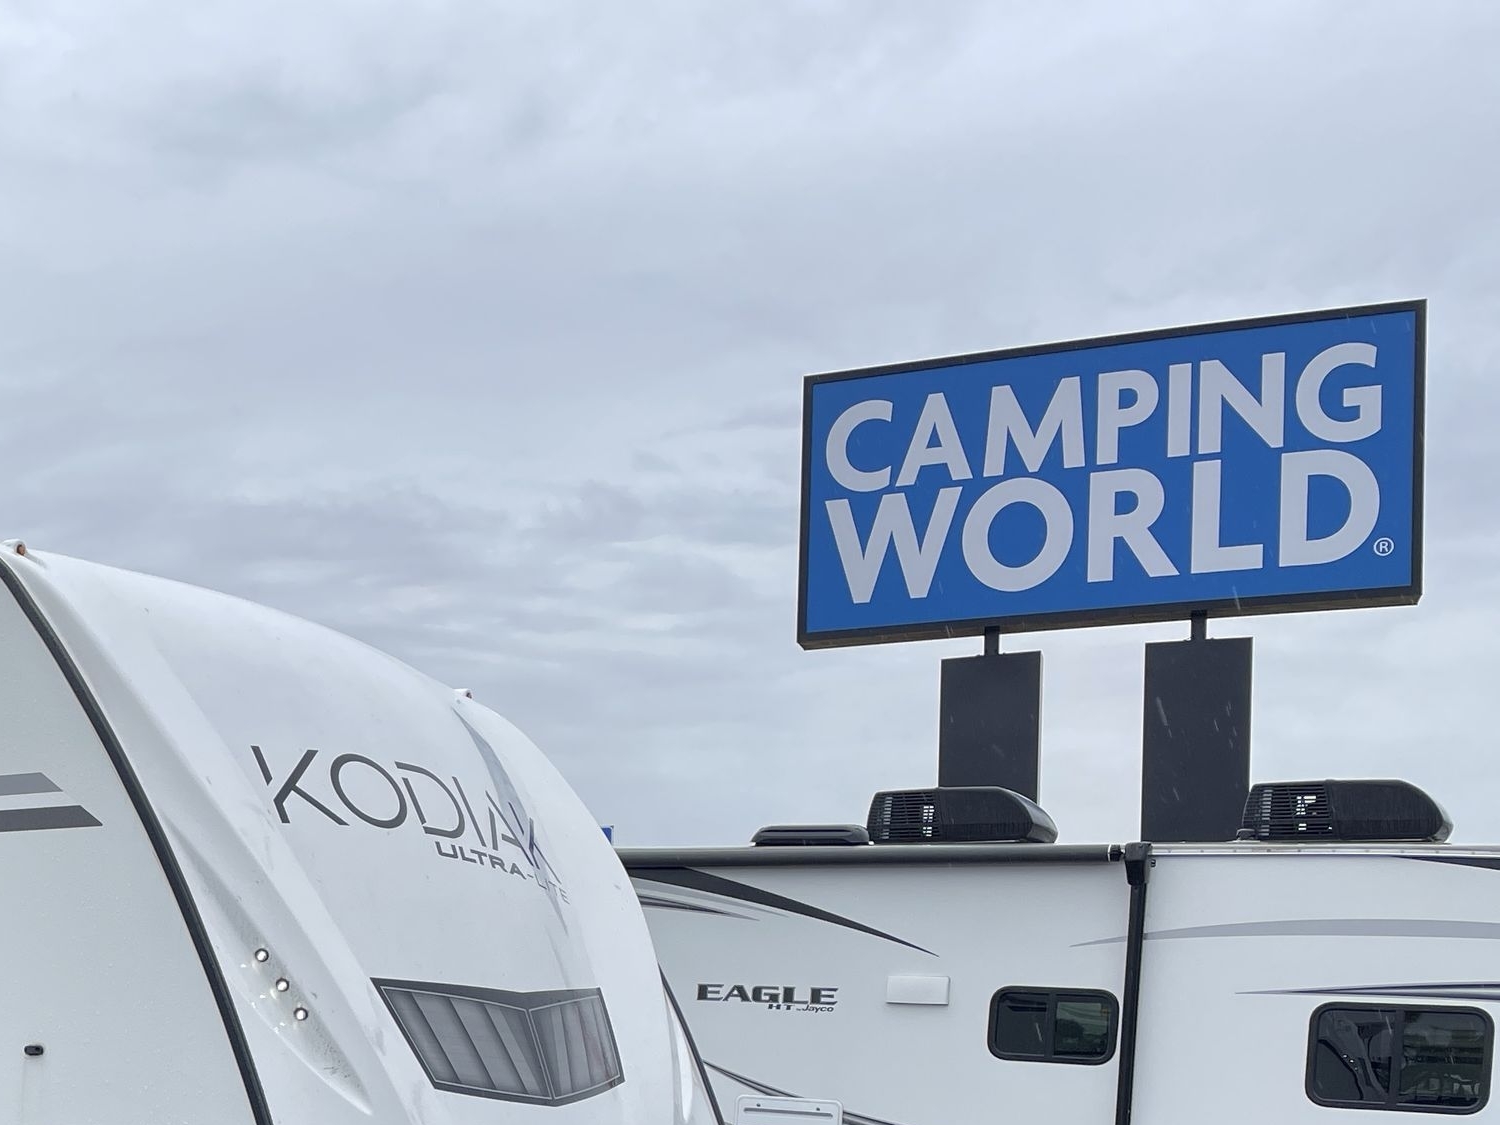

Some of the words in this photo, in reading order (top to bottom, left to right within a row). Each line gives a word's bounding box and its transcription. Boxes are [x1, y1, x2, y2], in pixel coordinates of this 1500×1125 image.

[825, 342, 1383, 492] CAMPING
[825, 449, 1382, 604] WORLD
[250, 744, 562, 885] KODIAK
[696, 983, 839, 1006] EAGLE
